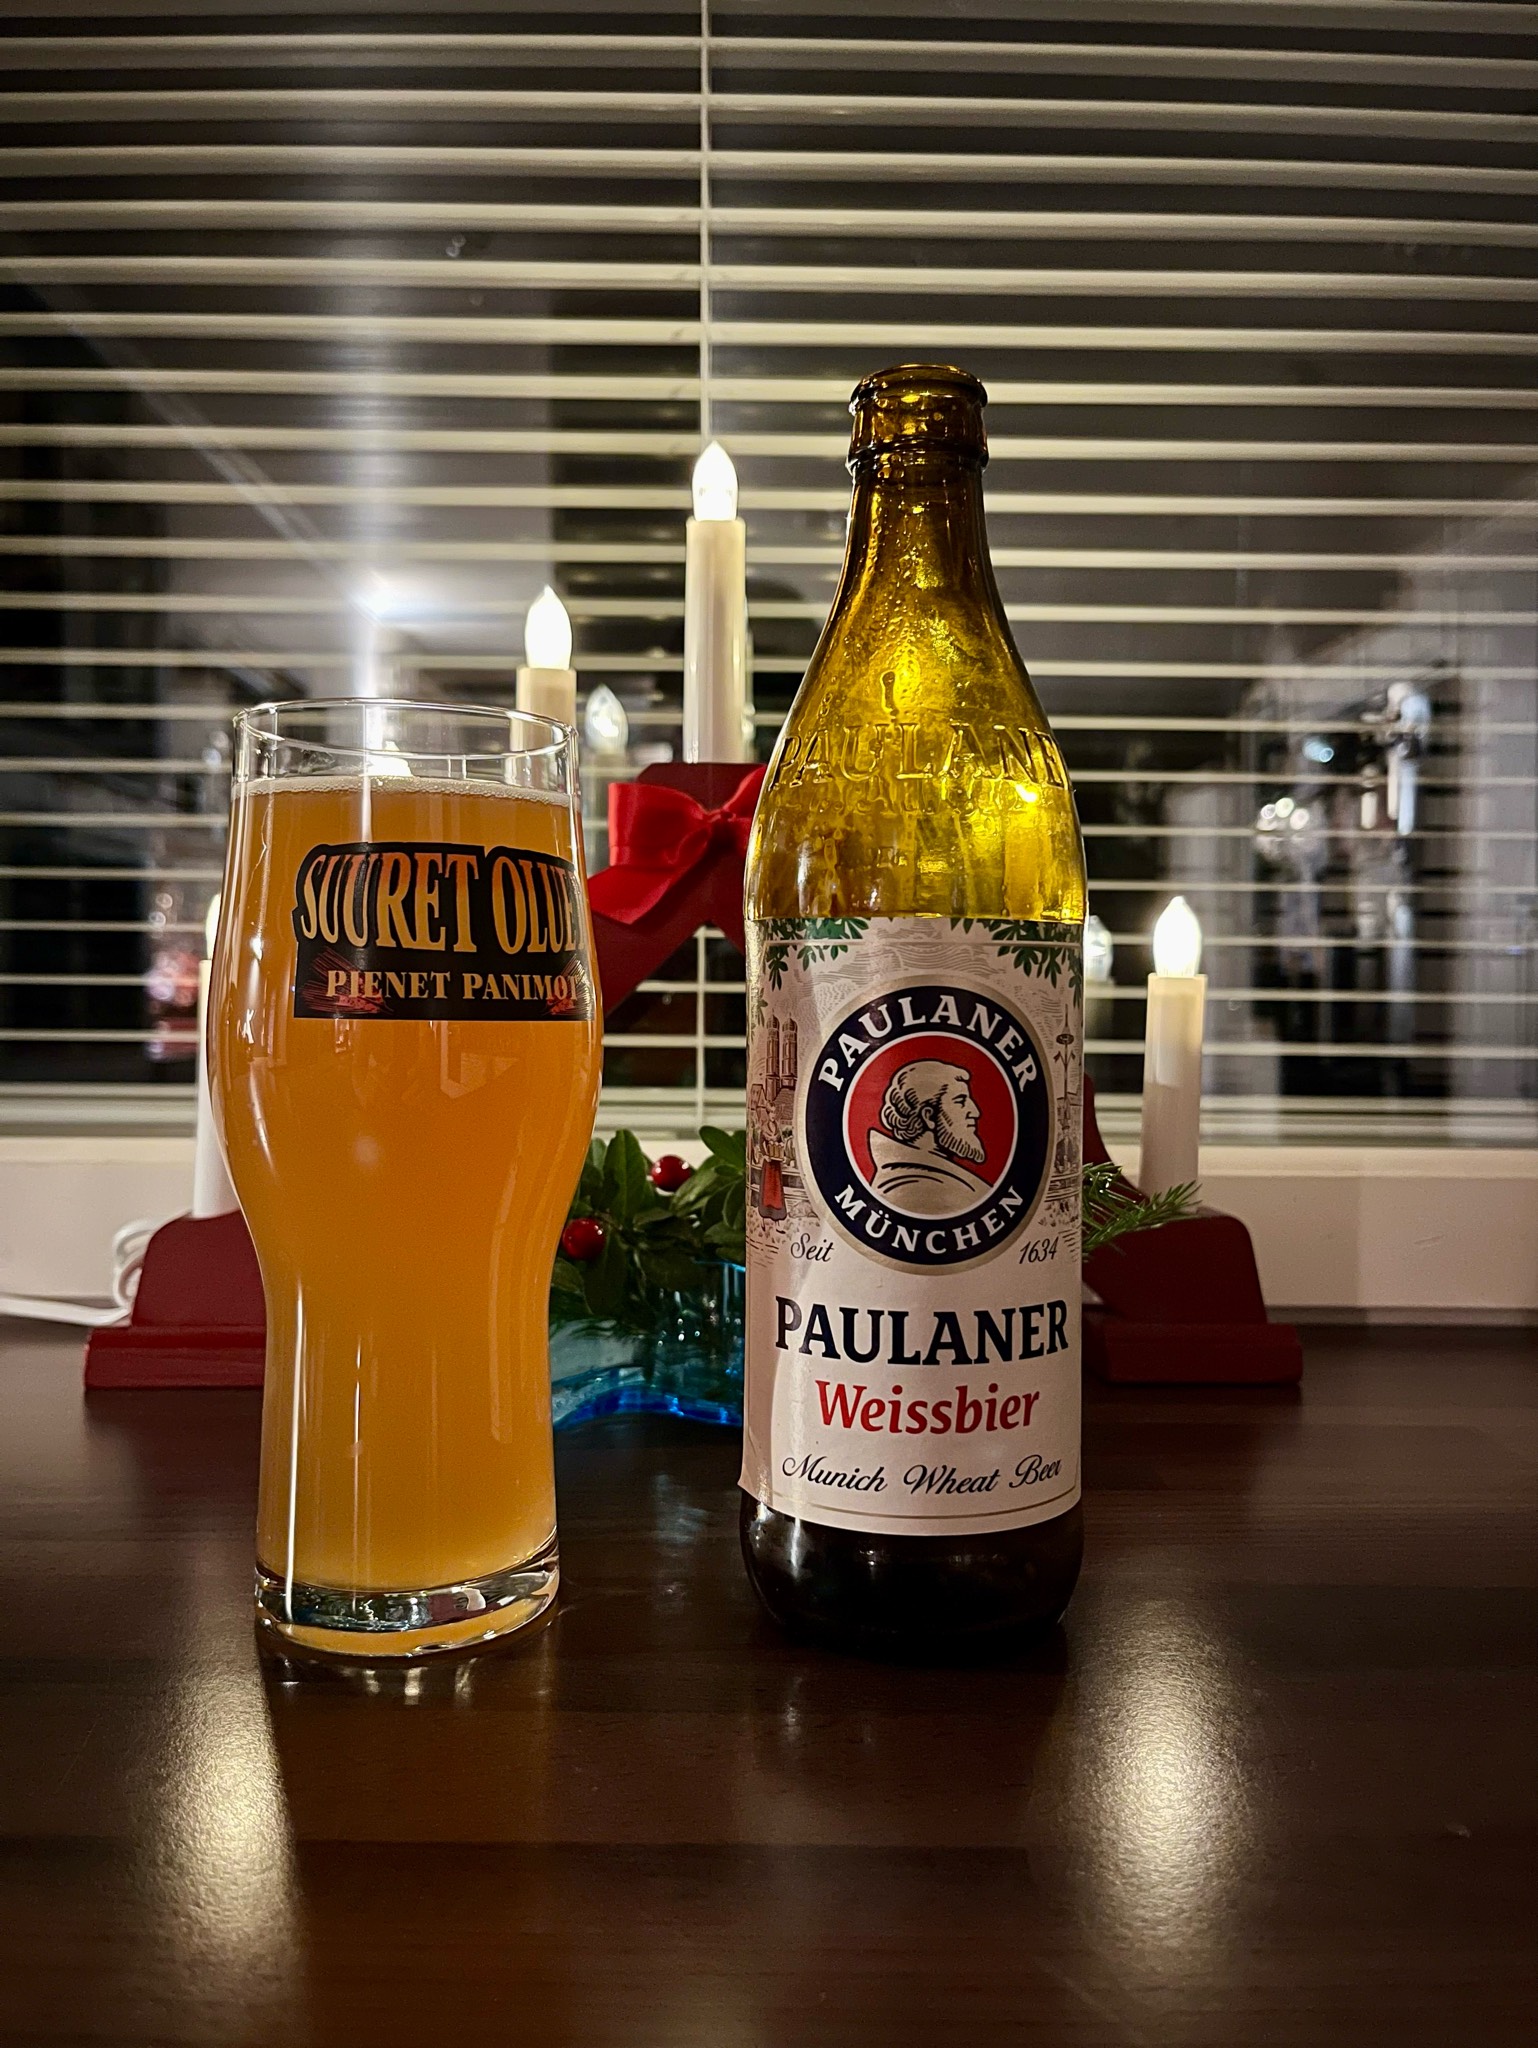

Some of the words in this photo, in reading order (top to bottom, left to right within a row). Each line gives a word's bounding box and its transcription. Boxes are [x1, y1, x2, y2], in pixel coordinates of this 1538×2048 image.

[769, 723, 1069, 791] PAULANE
[301, 852, 479, 952] SUURET
[326, 969, 450, 999] PIENET
[818, 995, 1038, 1092] PAULANER
[790, 1232, 834, 1262] Seit
[1019, 1237, 1059, 1264] 1634
[834, 1184, 1024, 1254] MÜNCHEN
[775, 1295, 1069, 1366] PAULANER
[815, 1380, 1040, 1435] Weissbier
[782, 1453, 888, 1492] Munich
[903, 1463, 1001, 1495] Wheat
[1008, 1454, 1061, 1489] Beer
